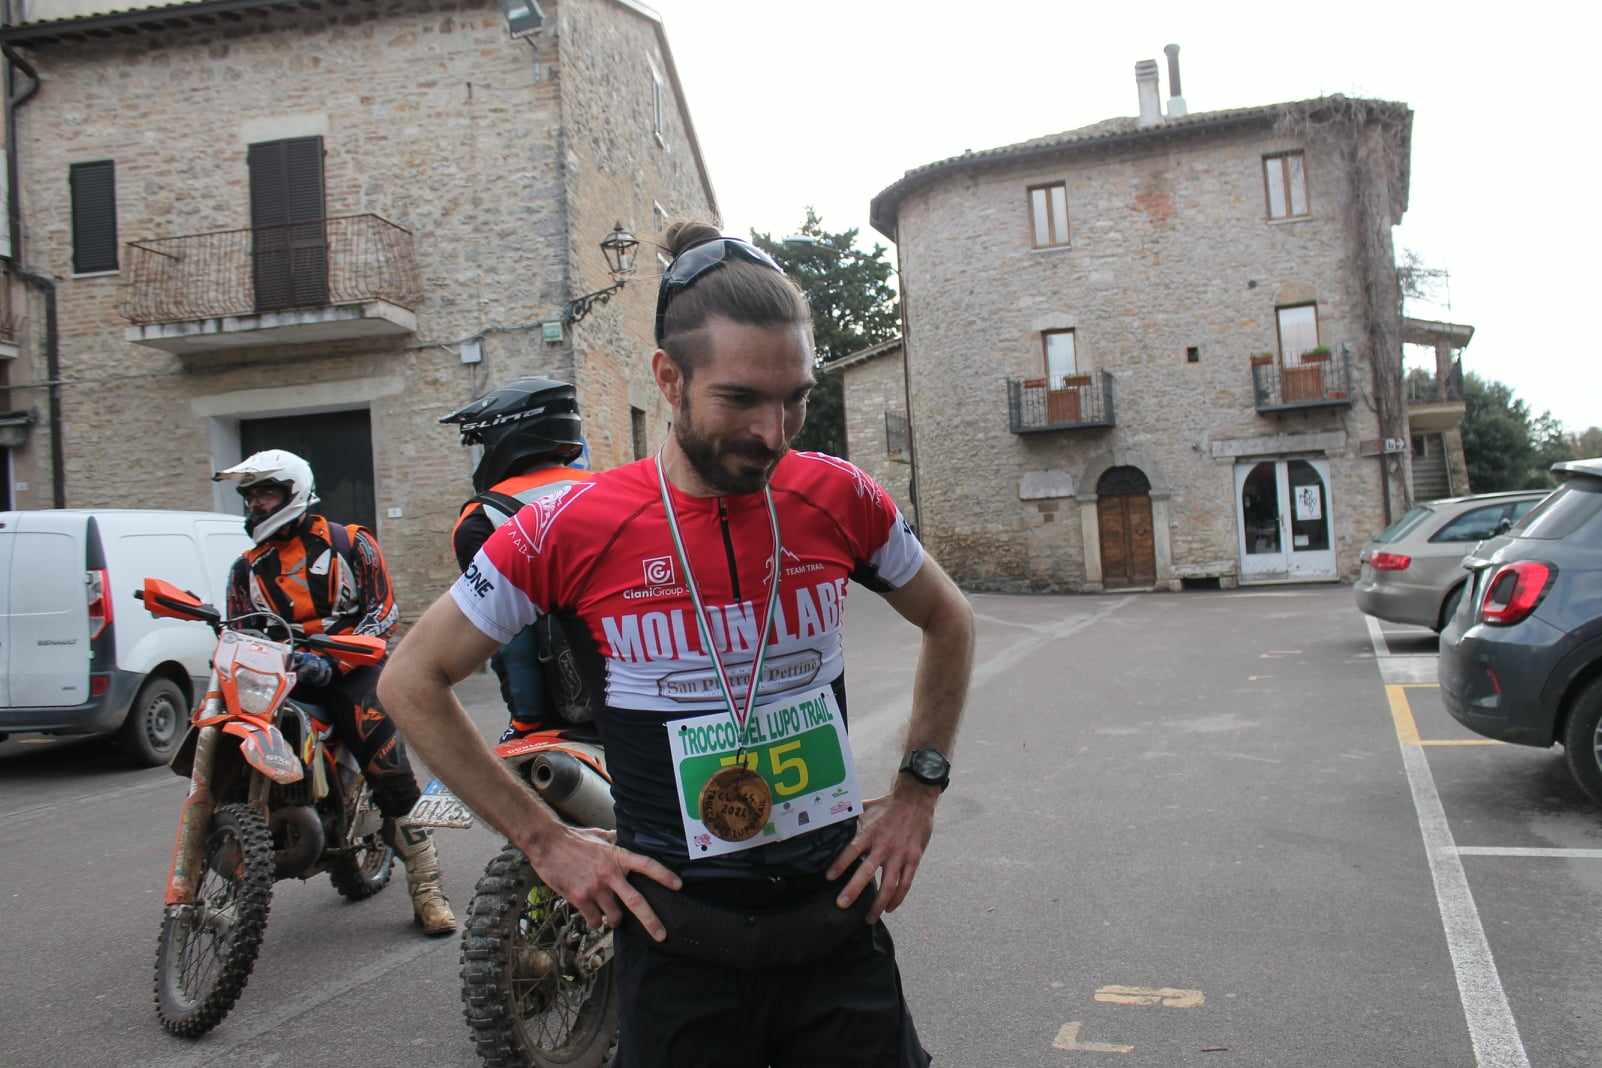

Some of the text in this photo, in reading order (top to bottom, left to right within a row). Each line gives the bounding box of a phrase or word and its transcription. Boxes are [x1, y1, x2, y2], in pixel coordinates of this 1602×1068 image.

[464, 561, 495, 598] ONE
[786, 563, 825, 576] TEAM TRAIL
[623, 586, 683, 600] CianiGroup
[601, 601, 759, 663] MOLON
[666, 679, 698, 694] San
[702, 674, 751, 692] Pitro
[766, 706, 802, 739] LUPO
[799, 696, 834, 728] TRAIL
